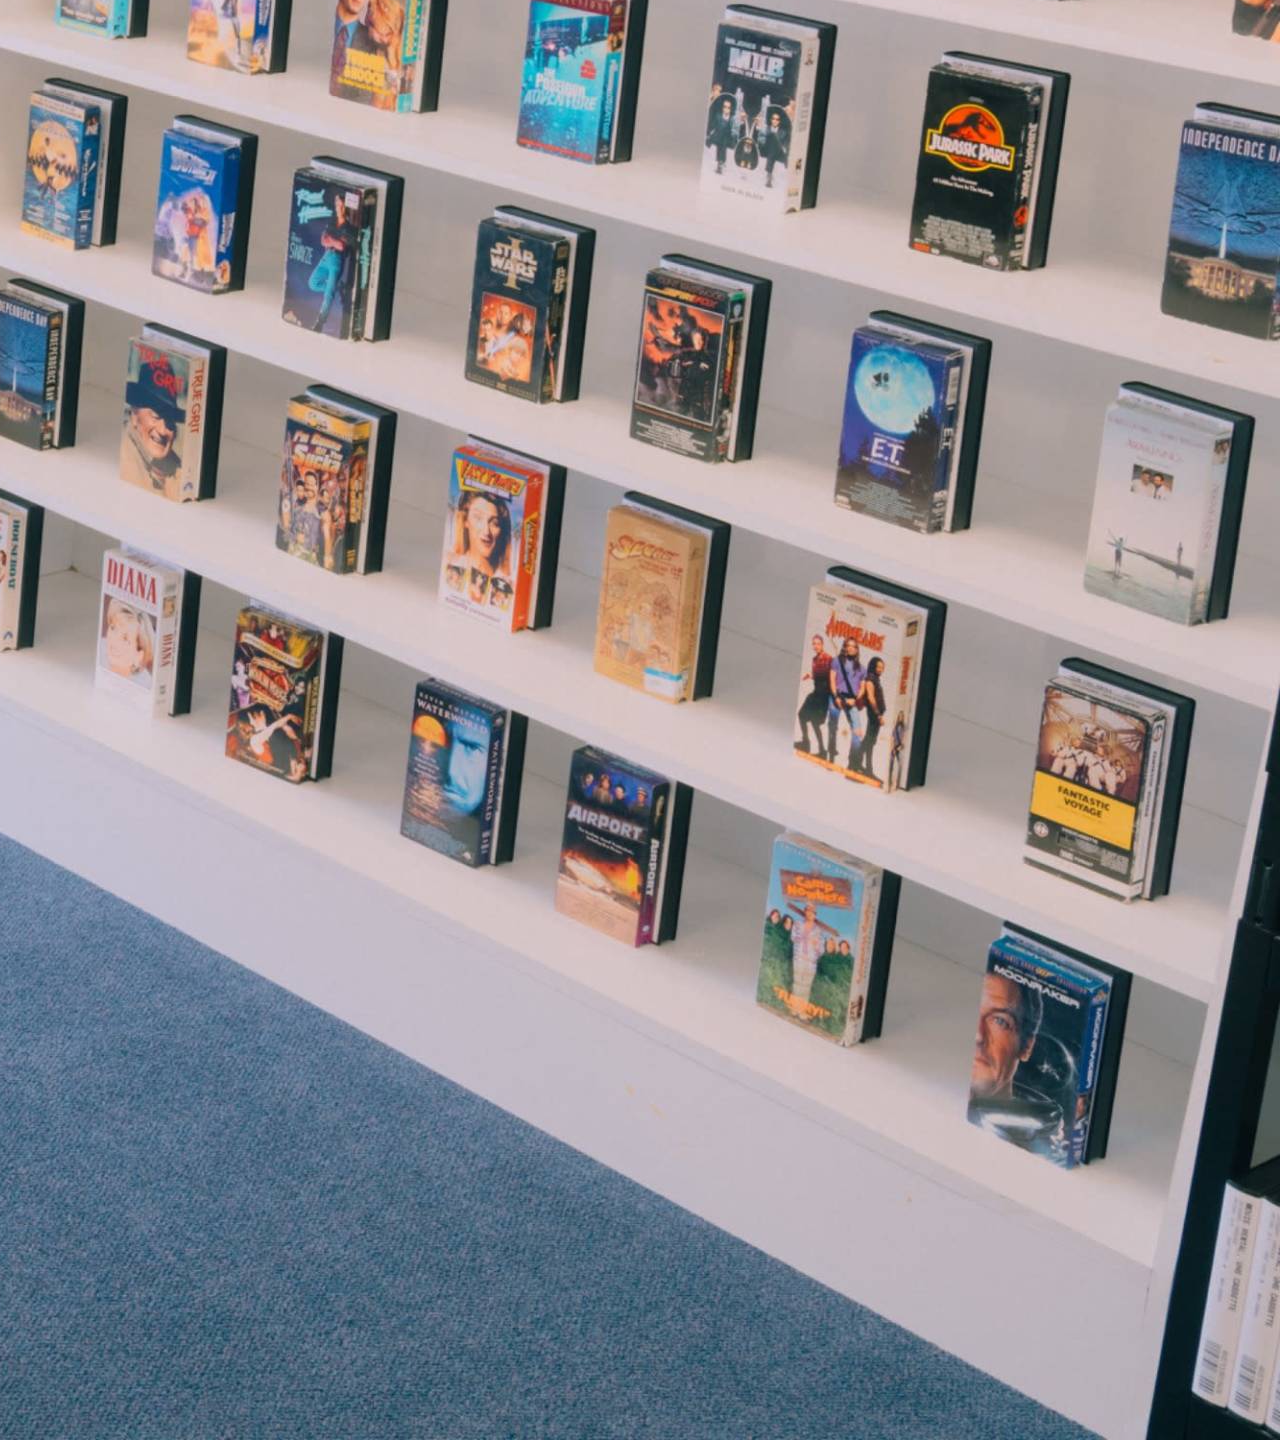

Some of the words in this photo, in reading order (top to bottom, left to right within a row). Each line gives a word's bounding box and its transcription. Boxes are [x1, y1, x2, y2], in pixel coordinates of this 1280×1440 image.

[522, 89, 598, 112] ADVENTURE
[930, 131, 978, 161] JURASSIC
[976, 141, 1013, 167] PARK
[1182, 127, 1267, 162] INDEPENDENCE
[490, 241, 537, 267] STAR
[490, 252, 538, 282] WARS
[33, 311, 48, 328] DAY
[47, 329, 60, 385] INDEPENDENCE
[137, 343, 168, 368] TRUE
[152, 367, 185, 393] GRIT
[190, 369, 205, 399] TRUE
[189, 399, 203, 433] GRIT
[870, 437, 906, 466] E.T.
[944, 426, 956, 450] E.T.
[8, 518, 22, 591] HOUSEBOAT
[106, 558, 158, 606] DIANA
[825, 611, 885, 654] AIRHEADS
[161, 633, 175, 667] DIANA
[416, 697, 490, 734] WATERWORLD
[486, 739, 501, 822] WATERWORLD
[1057, 786, 1111, 813] FANTASTIC
[1063, 797, 1104, 819] VOYAGE
[567, 805, 644, 841] AIRPORT
[646, 838, 660, 897] AIRPORT
[993, 964, 1081, 1009] MOONRAKER
[1085, 1005, 1104, 1091] MOONRAKER
[1242, 1202, 1254, 1225] MOVIE
[1228, 1275, 1243, 1312] CASSETTE
